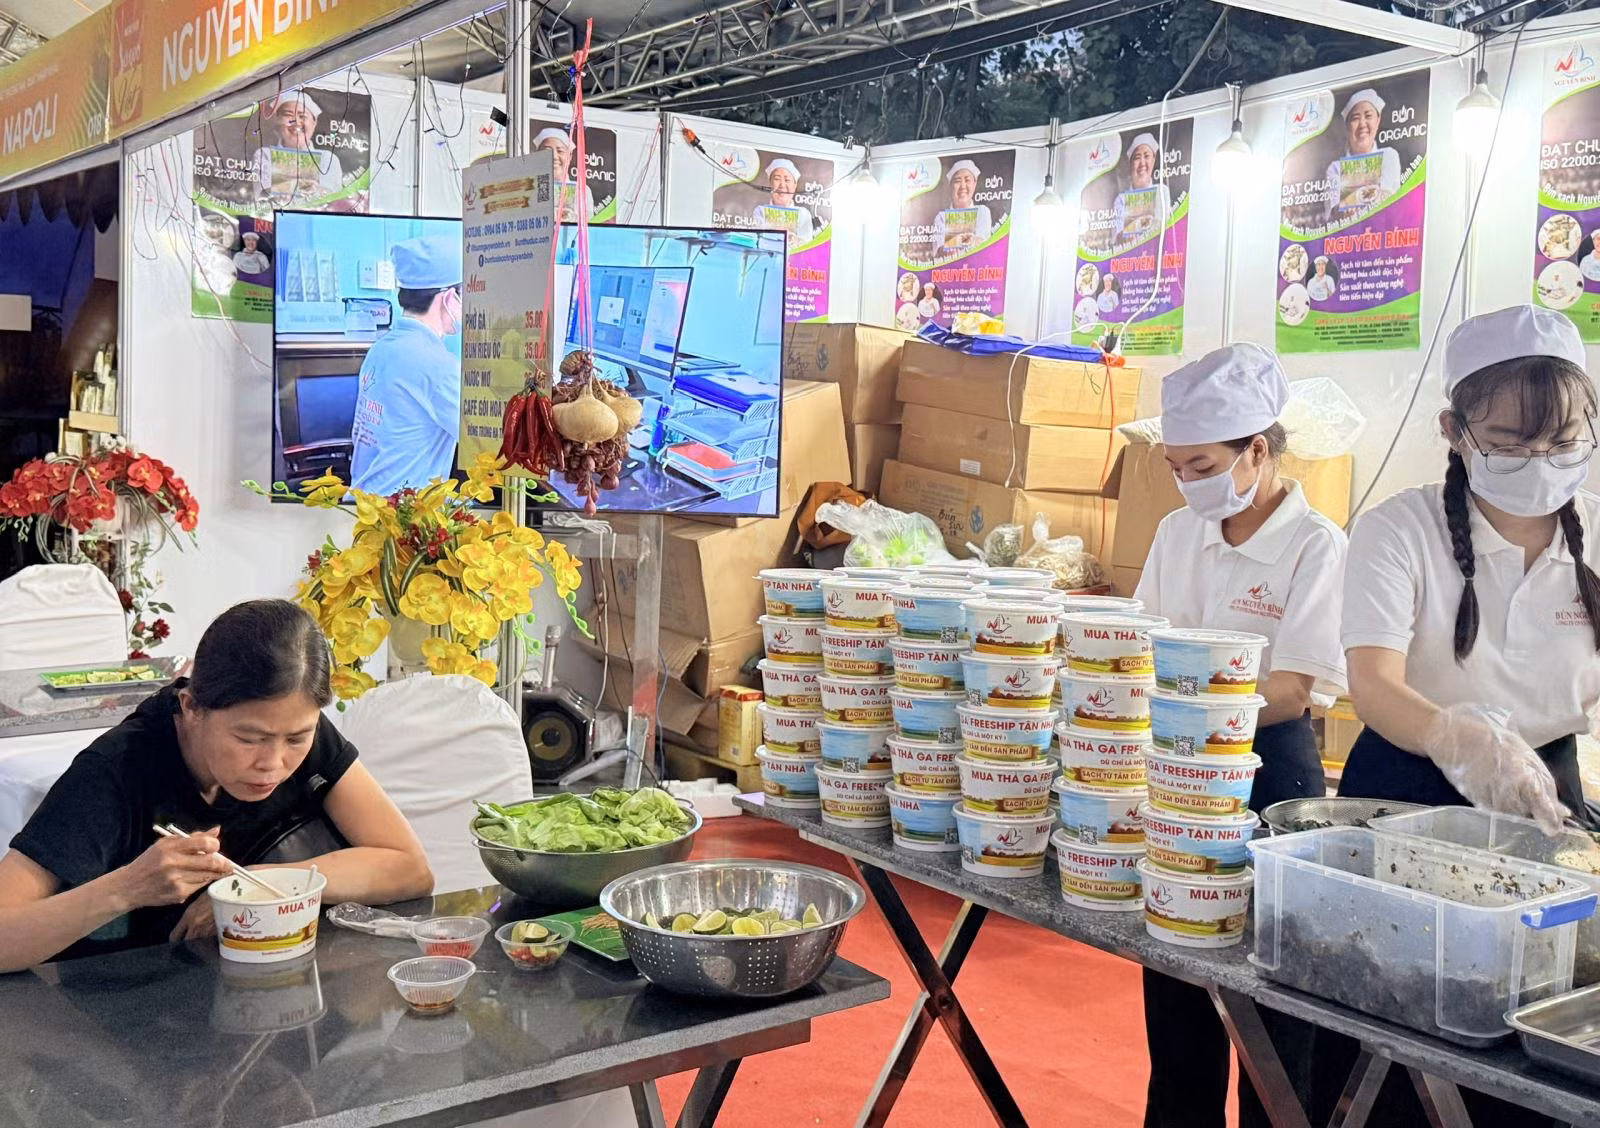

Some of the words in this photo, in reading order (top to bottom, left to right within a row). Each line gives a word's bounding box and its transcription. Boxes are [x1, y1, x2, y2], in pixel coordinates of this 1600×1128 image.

[3, 93, 59, 155] NAPOLI
[87, 114, 103, 138] 018
[1379, 123, 1427, 144] ORGANIC
[315, 133, 369, 152] ORGAC
[570, 166, 616, 182] OGANIC
[1153, 164, 1191, 180] OGANIC
[975, 190, 1013, 203] ORGANIC
[1324, 227, 1382, 255] NGUYỄN
[1385, 227, 1419, 249] BÍNH
[1111, 250, 1155, 273] NGUYỄN
[1161, 251, 1184, 269] ÍNH
[932, 264, 976, 283] NGUYỄN
[466, 273, 487, 294] Menu
[855, 592, 878, 601] MUA
[1027, 615, 1048, 624] MUA
[825, 636, 863, 649] FREESHIP
[1083, 628, 1110, 640] MUA
[1113, 628, 1138, 641] THẢ
[860, 687, 876, 697] GA
[776, 718, 796, 728] MUA
[970, 717, 1016, 731] FREESHIP
[1018, 720, 1039, 733] TẬN
[1073, 739, 1095, 752] THẢ
[1097, 743, 1117, 755] GA
[916, 752, 932, 762] GA
[971, 769, 993, 781] MUA
[997, 770, 1019, 783] THẢ
[1022, 773, 1038, 783] GA
[1162, 764, 1218, 780] FREESHIP
[1221, 767, 1244, 783] TẬN
[834, 780, 849, 790] GA
[1176, 781, 1191, 791] MỘT
[1068, 851, 1118, 868] FREESHIP
[1189, 888, 1219, 901] MUA
[278, 902, 305, 916] MUA
